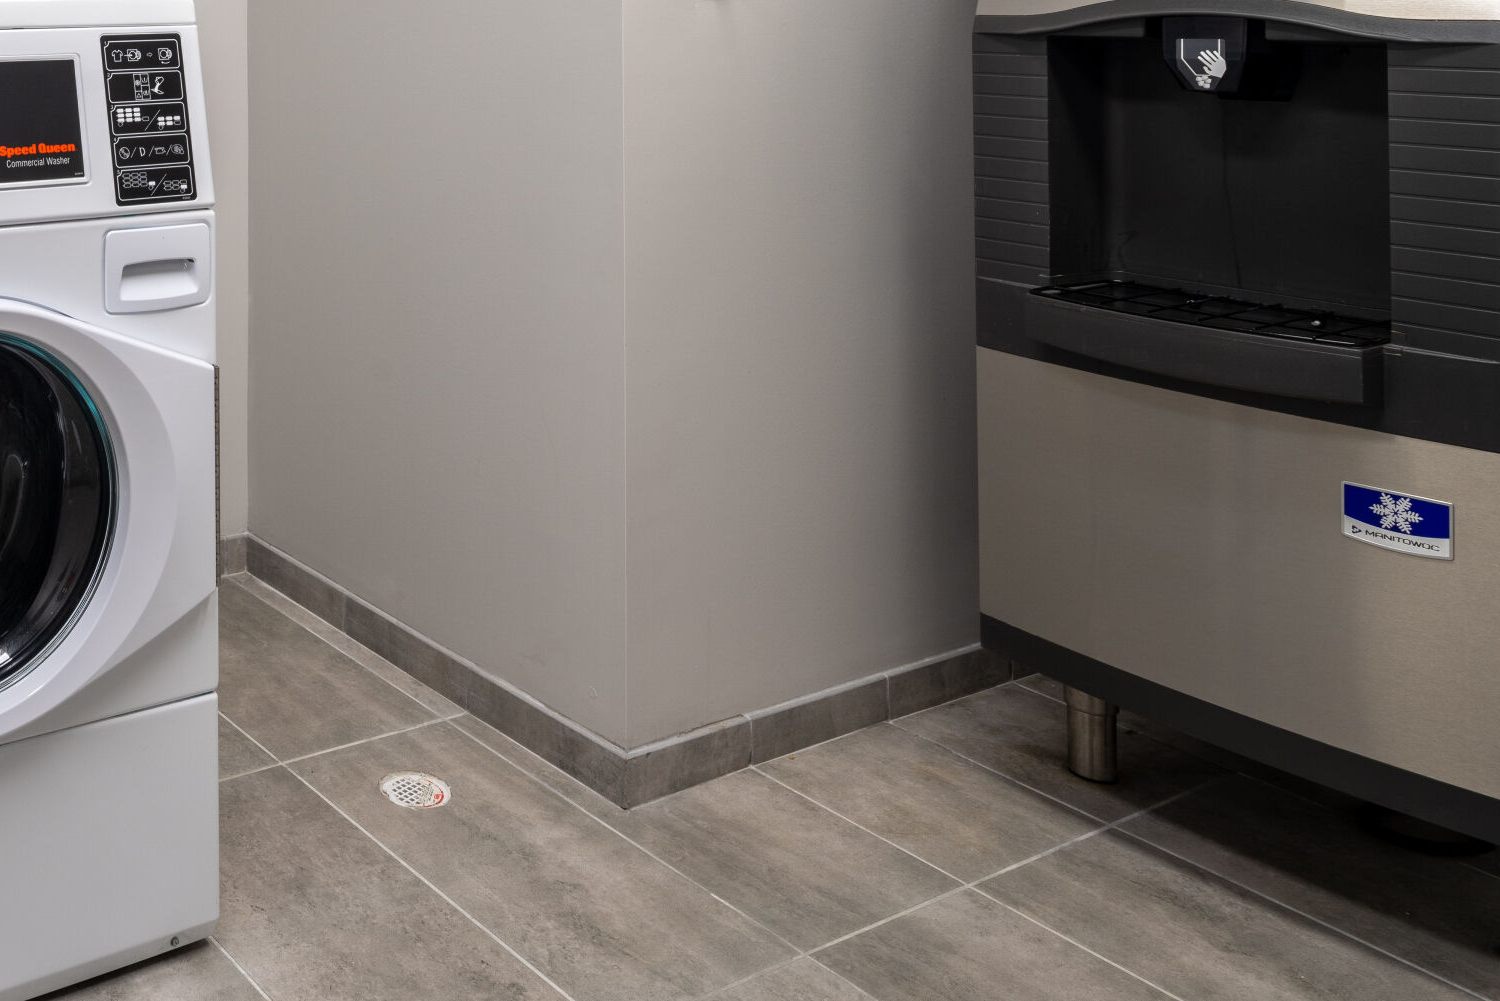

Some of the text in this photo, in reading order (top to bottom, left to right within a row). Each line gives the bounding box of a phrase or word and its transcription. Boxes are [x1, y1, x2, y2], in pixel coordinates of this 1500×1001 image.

[39, 142, 76, 154] Queen
[6, 156, 70, 168] Commercial Washer
[1365, 529, 1440, 552] MANITOWOC
